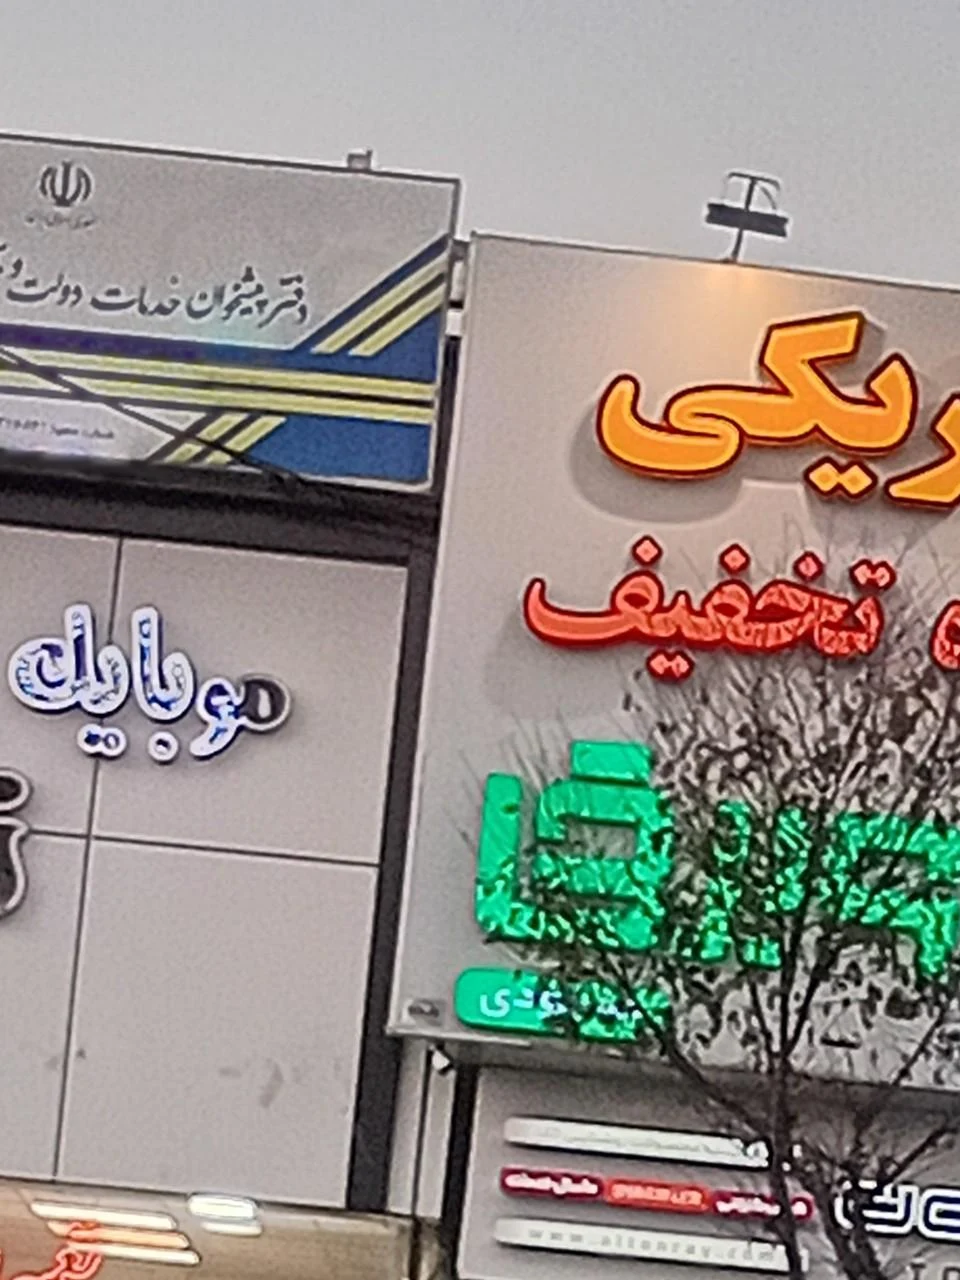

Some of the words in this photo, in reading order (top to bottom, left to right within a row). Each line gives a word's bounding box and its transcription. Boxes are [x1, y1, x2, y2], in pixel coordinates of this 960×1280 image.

[6, 272, 83, 307] دولت
[90, 275, 181, 316] خدمات
[524, 535, 896, 682] تخفیف
[8, 603, 292, 764] موبایل
